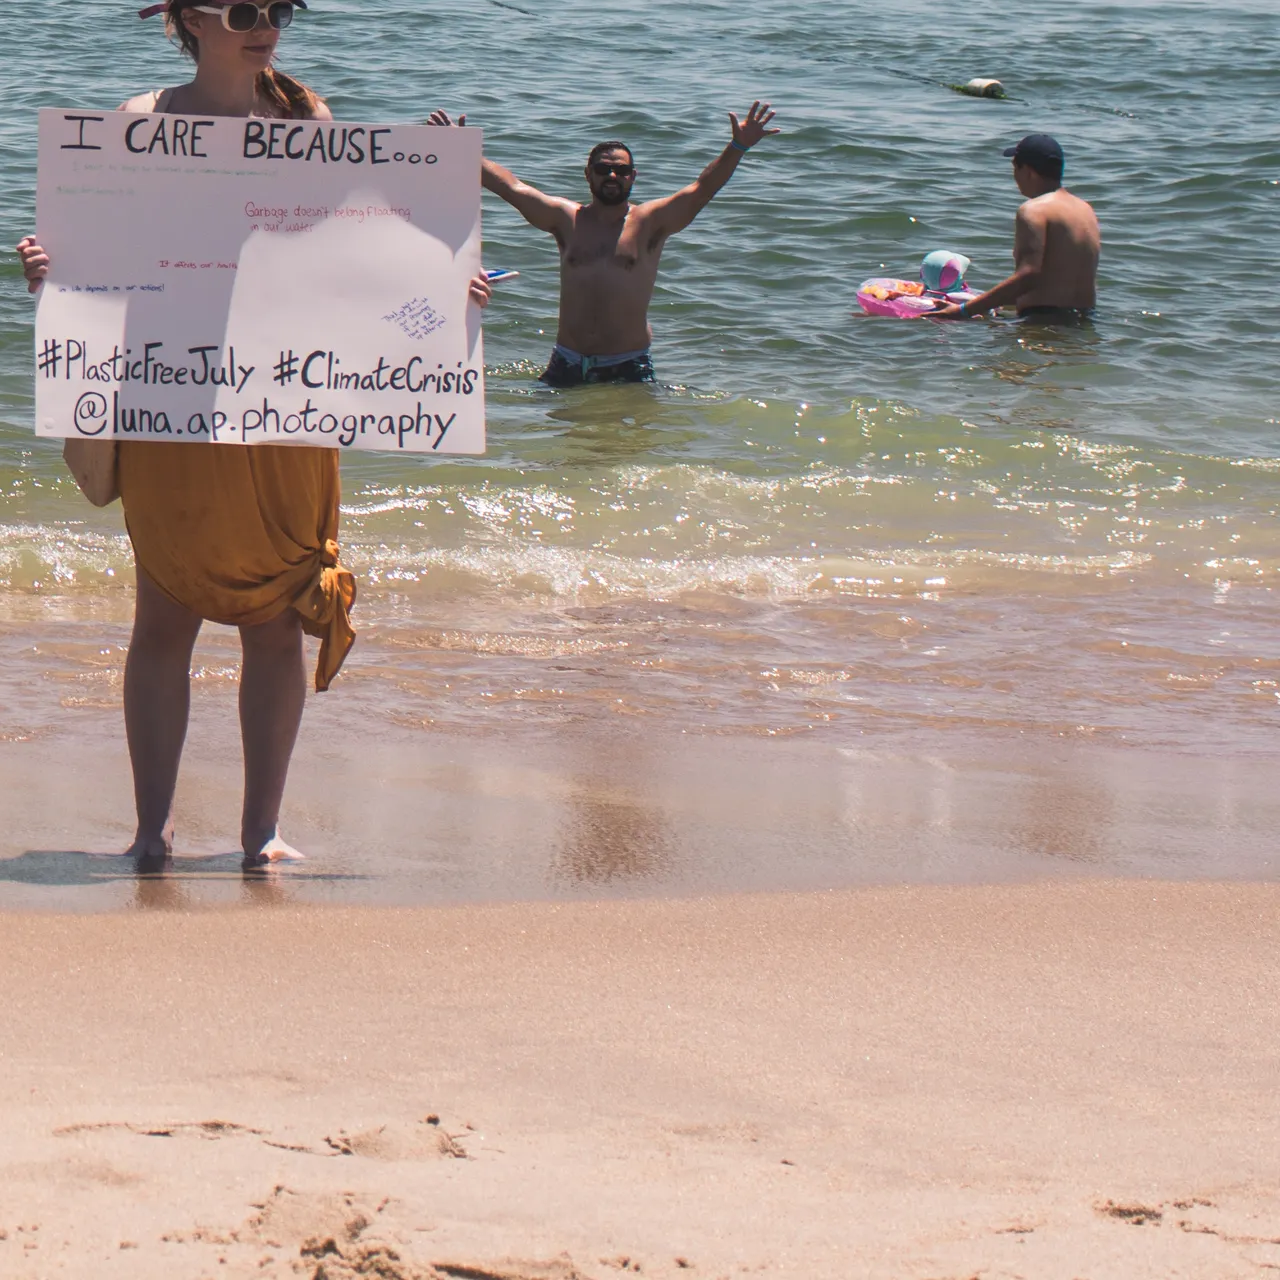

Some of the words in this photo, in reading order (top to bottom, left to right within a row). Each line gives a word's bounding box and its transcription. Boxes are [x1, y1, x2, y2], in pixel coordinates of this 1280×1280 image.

[60, 115, 104, 151] I
[125, 118, 215, 158] CARE
[245, 201, 289, 224] Garbage
[294, 205, 330, 218] doesn't
[334, 206, 365, 223] belong
[264, 222, 280, 232] our
[285, 222, 314, 232] water
[38, 339, 256, 394] #PlasticFreeJuly
[273, 349, 479, 396] #ClimateCrisis
[73, 391, 457, 451] @luna.ap.photography
